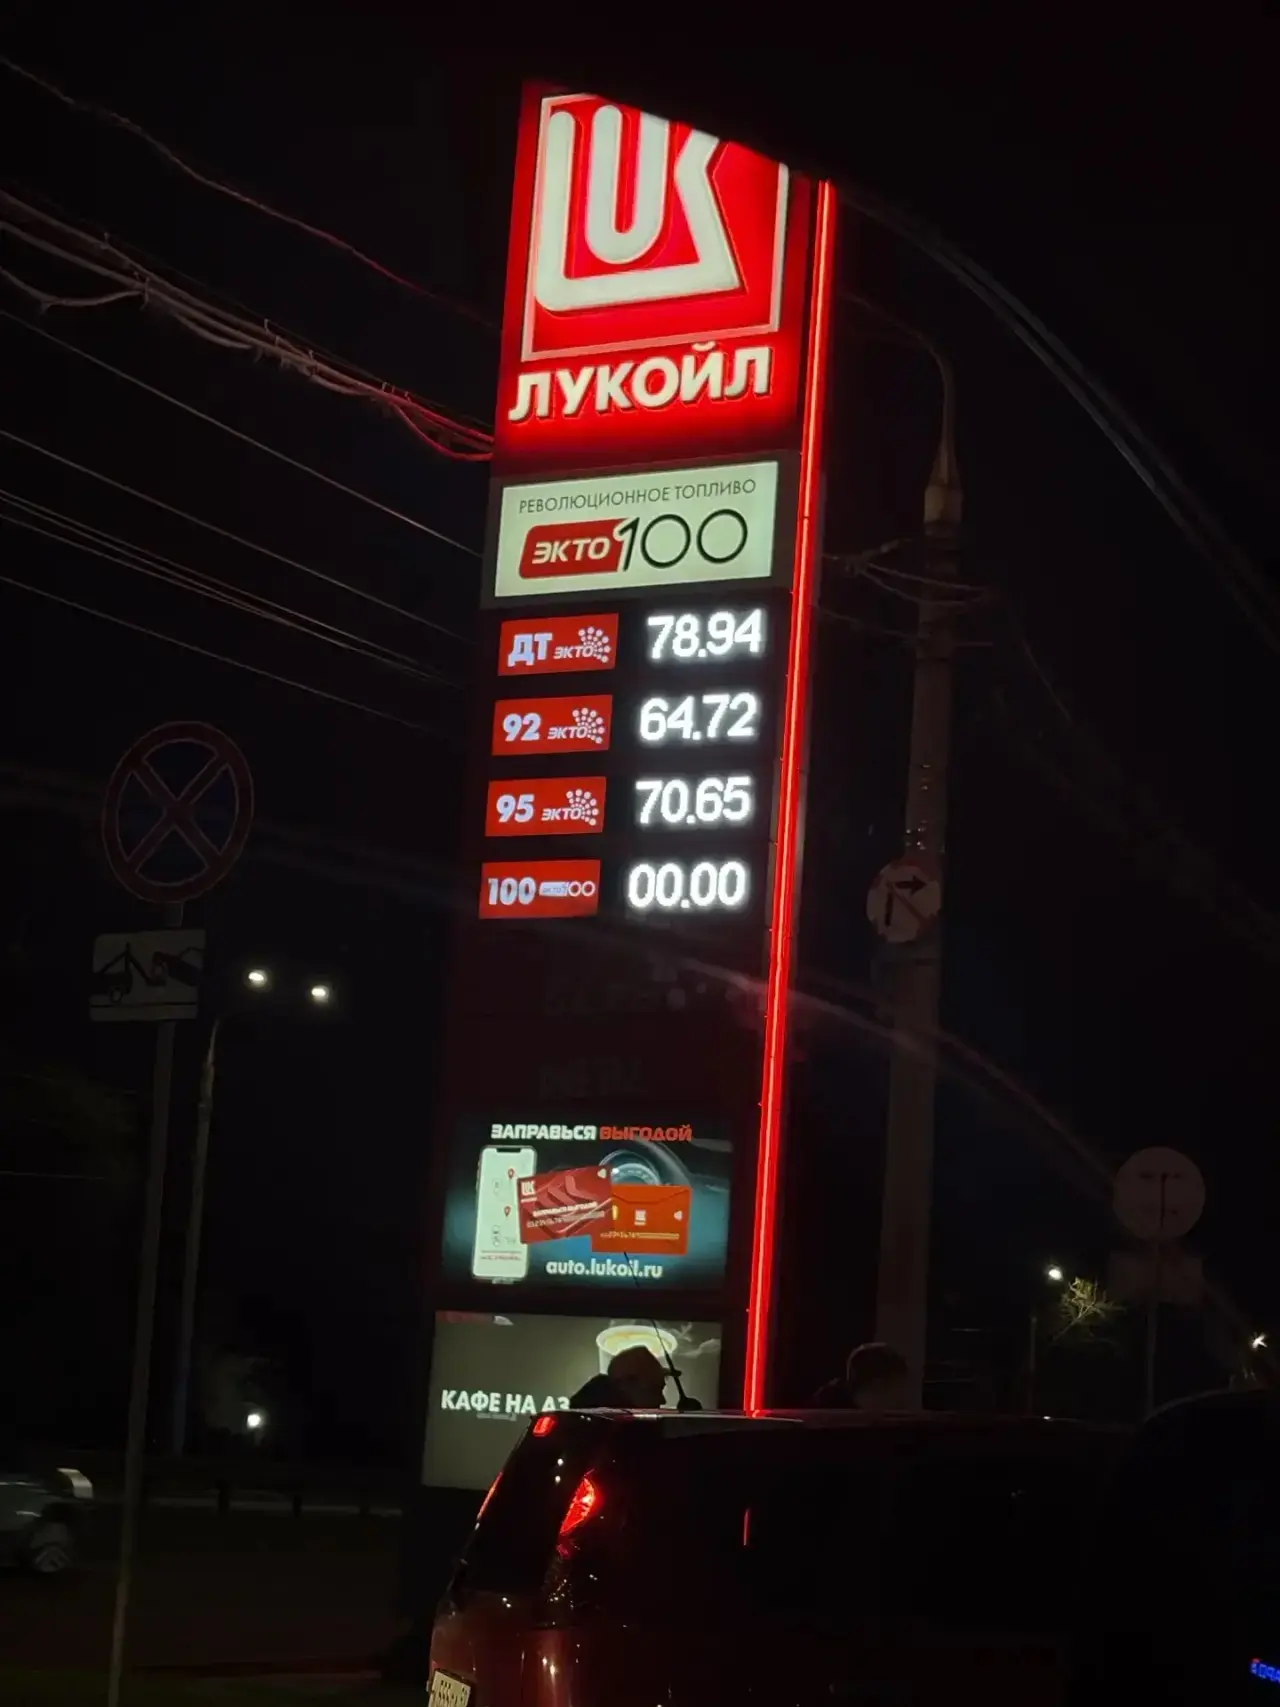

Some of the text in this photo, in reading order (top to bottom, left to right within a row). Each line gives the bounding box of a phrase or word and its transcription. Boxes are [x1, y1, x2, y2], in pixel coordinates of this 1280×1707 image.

[508, 341, 772, 421] ЛУКОЙЛ
[518, 479, 757, 513] РЕВОЛЮЦИОННОЕ ТОПЛИВО
[531, 536, 611, 564] ЭКТО
[507, 632, 594, 667] ДТ ЭКТО
[646, 607, 763, 660] 78.94
[503, 712, 588, 742] 92 ЭКТО
[639, 691, 757, 741] 64.72
[496, 793, 582, 823] 95 ЭКТО
[635, 775, 752, 824] 70.65
[488, 876, 536, 906] 100
[628, 860, 747, 909] 00.00
[490, 1123, 693, 1141] ЗАПРАВЬСЯ ВЫГОДОЙ
[545, 1258, 663, 1279] auto.lukoil.ru
[441, 1389, 571, 1415] КАФЕ НА АЗ
